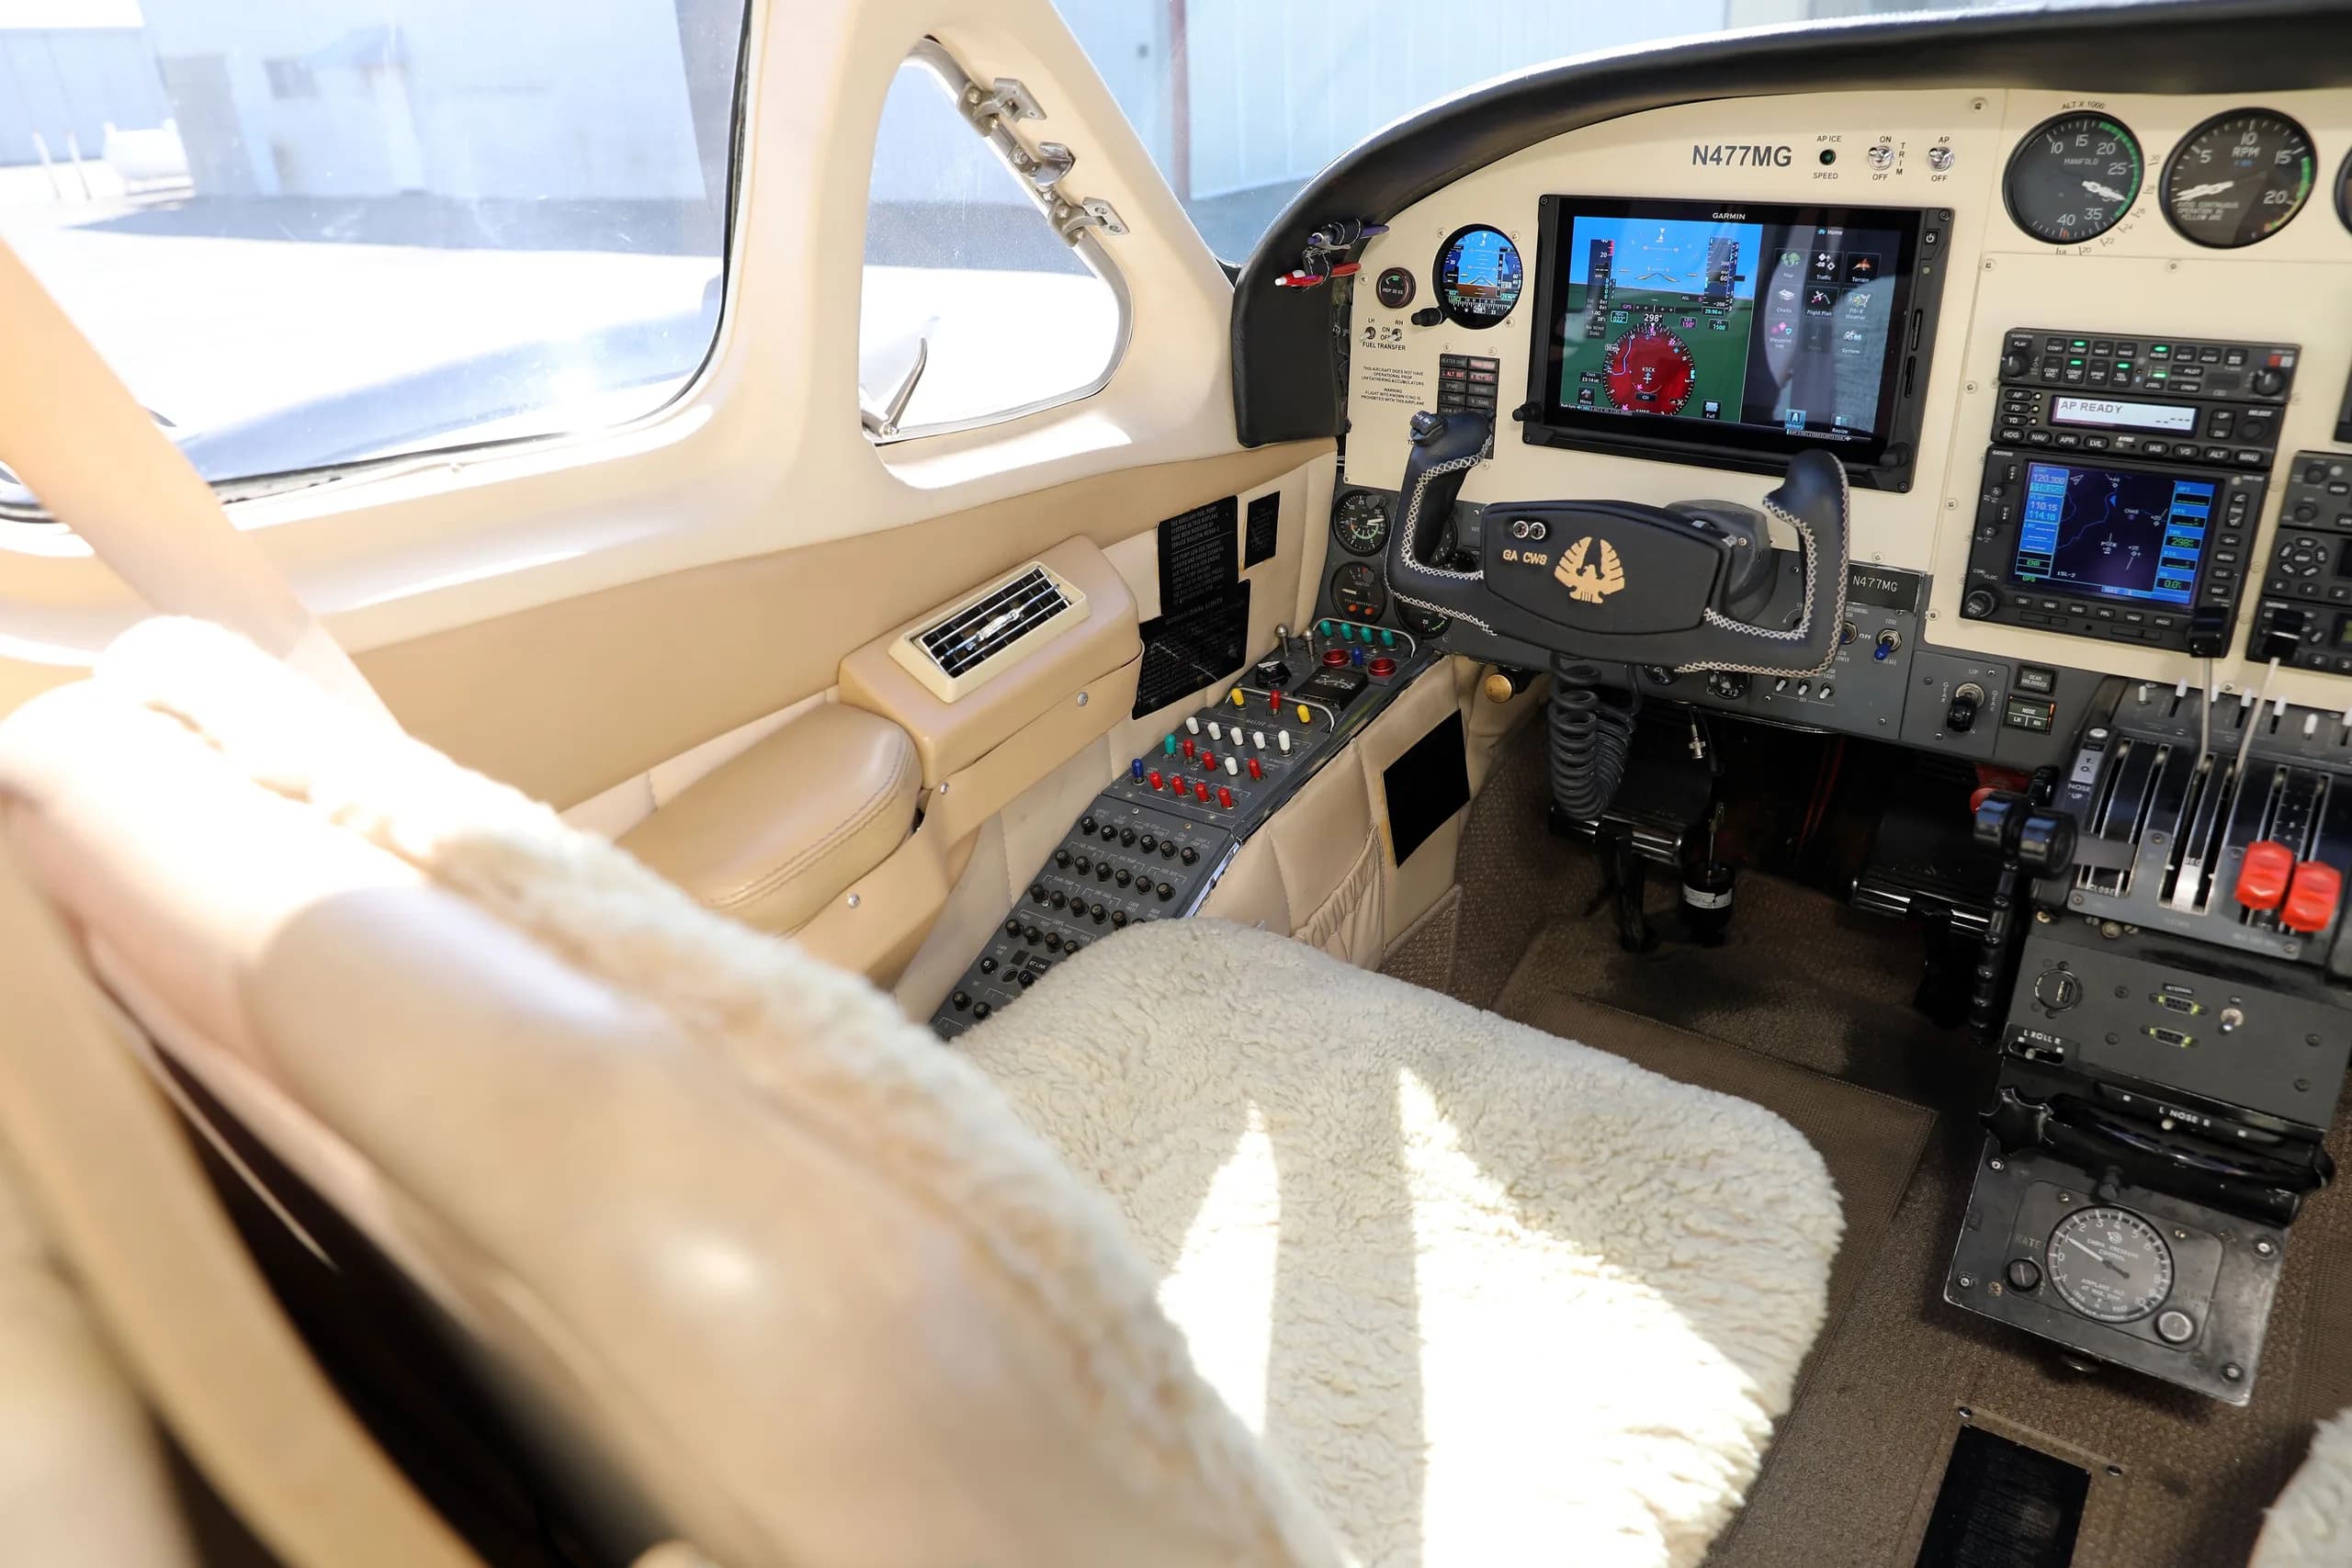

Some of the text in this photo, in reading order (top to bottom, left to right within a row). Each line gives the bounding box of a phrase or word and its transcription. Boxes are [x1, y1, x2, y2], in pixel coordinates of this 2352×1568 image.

[2075, 135, 2088, 147] 15
[2241, 132, 2258, 145] 10
[2051, 141, 2064, 154] 10
[2096, 142, 2116, 155] 20
[2232, 147, 2260, 157] RPM
[1691, 145, 1792, 167] N477MG
[2199, 151, 2212, 164] 5
[2274, 151, 2291, 164] 15
[2108, 163, 2127, 175] 25
[2263, 190, 2289, 204] 20
[2056, 214, 2075, 225] 40
[2084, 208, 2102, 220] 35
[1644, 314, 1662, 322] 298°
[2061, 400, 2123, 413] AP READY
[2030, 501, 2057, 511] 110.15
[1503, 550, 1548, 565] GA CWS
[1852, 575, 1897, 592] N477MG
[2087, 884, 2115, 896] CLOSE
[2165, 985, 2192, 994] INTERNAL
[2031, 1032, 2052, 1043] ROLL
[2169, 1111, 2199, 1123] NOSE
[2078, 1223, 2086, 1232] 2
[2096, 1219, 2103, 1227] 3
[2114, 1221, 2121, 1230] 4
[2132, 1229, 2139, 1239] 5
[2016, 1234, 2041, 1248] RATE
[2144, 1241, 2152, 1250] 6
[2057, 1252, 2064, 1261] 0
